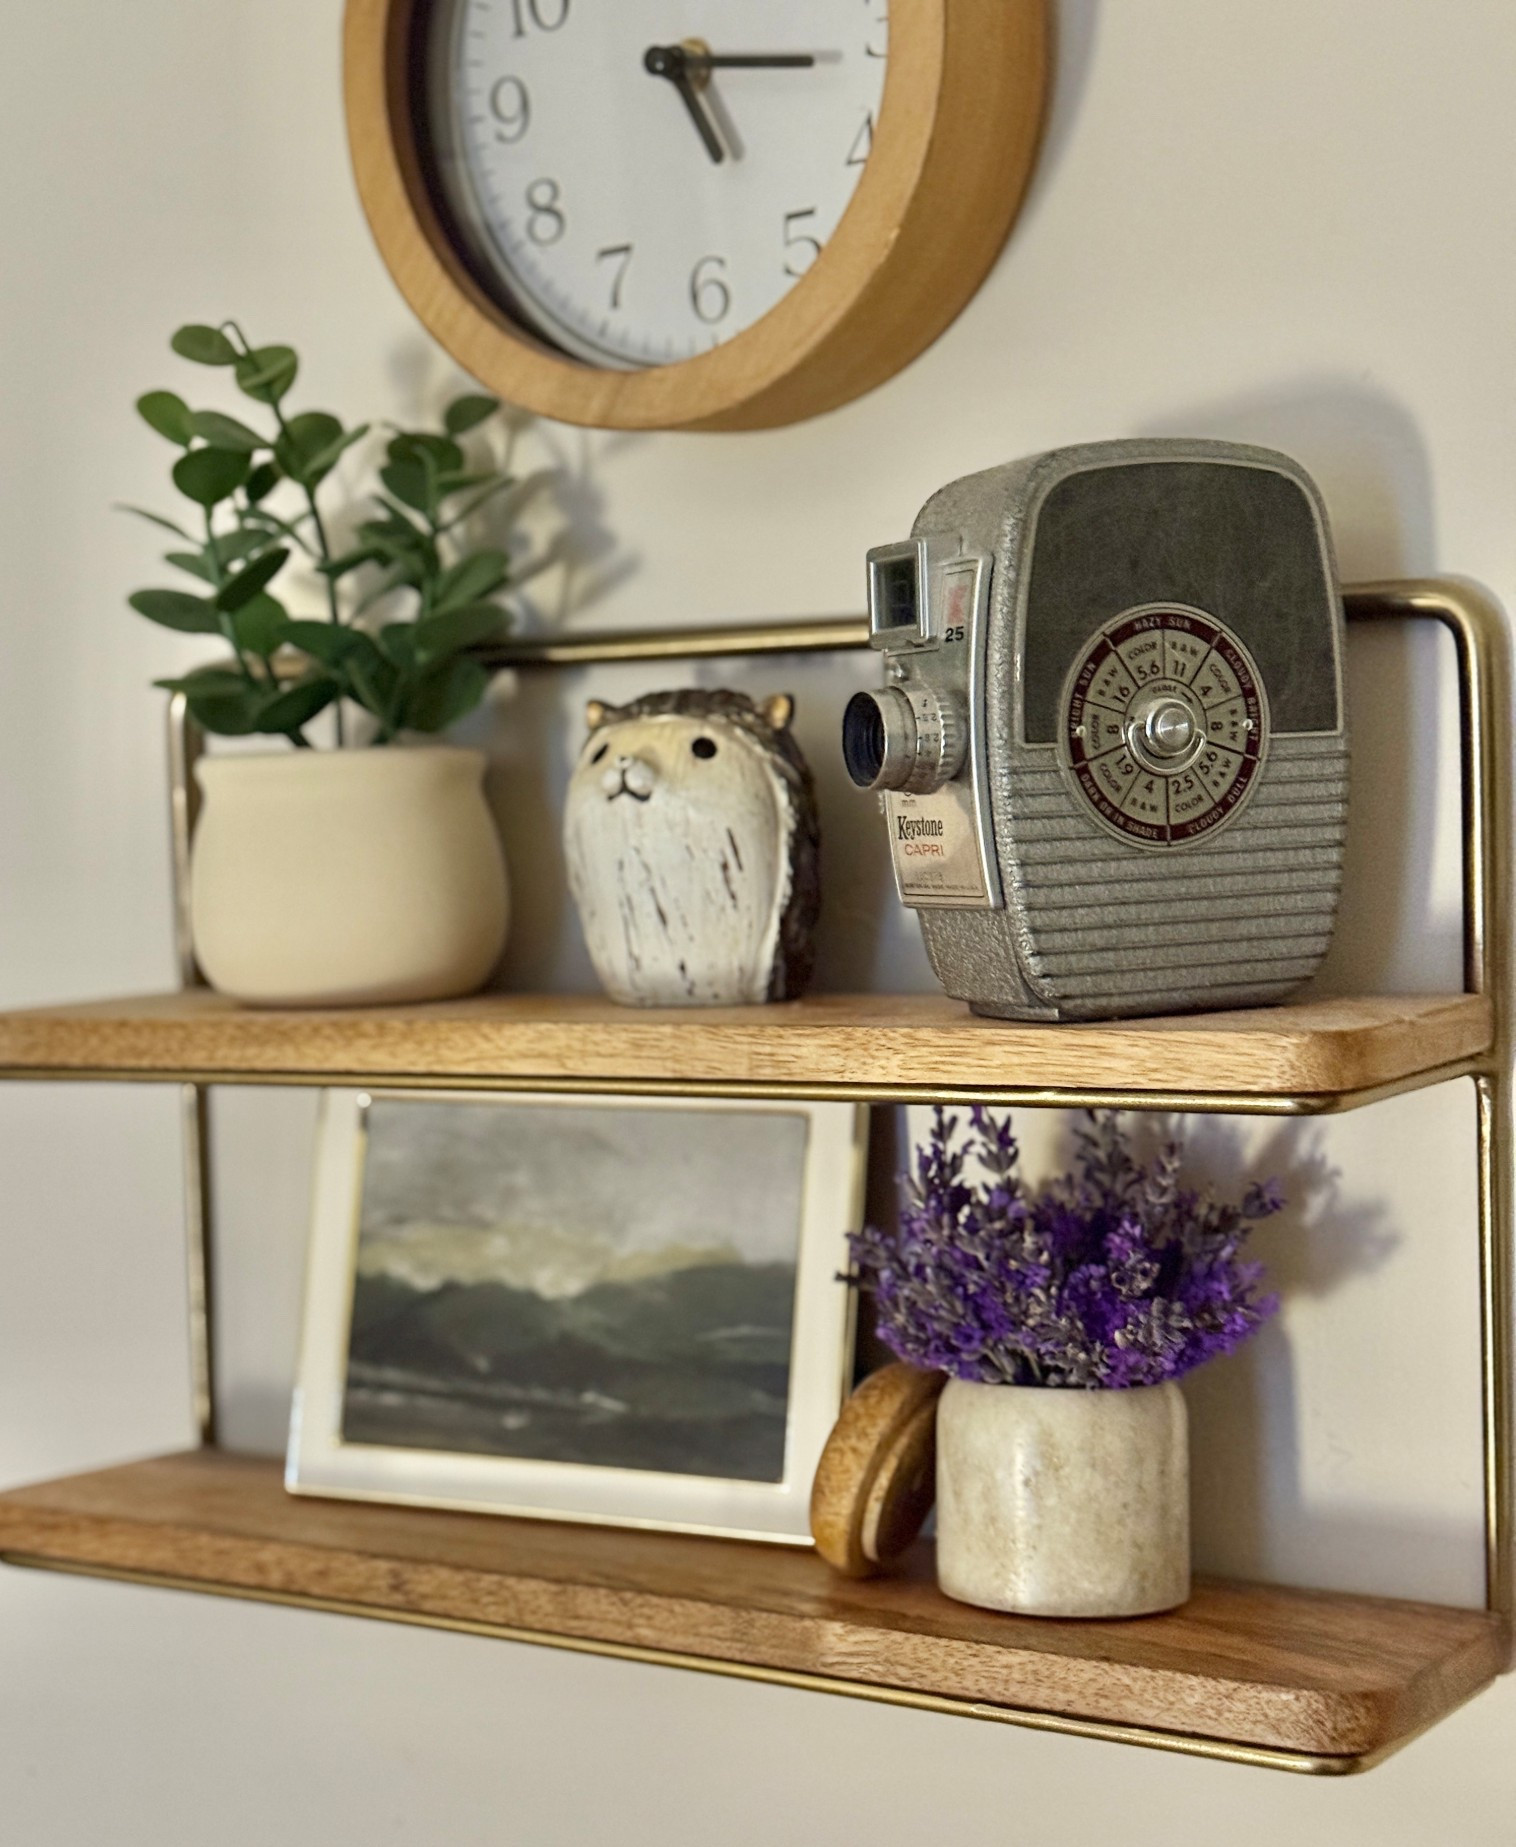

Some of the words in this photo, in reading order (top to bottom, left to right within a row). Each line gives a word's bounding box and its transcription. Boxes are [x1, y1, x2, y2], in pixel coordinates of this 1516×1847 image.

[510, 0, 571, 39] 10
[488, 74, 531, 145] 9
[525, 177, 566, 247] 8
[783, 207, 822, 277] 5
[595, 243, 633, 310] 7
[688, 254, 731, 325] 6
[944, 626, 964, 642] 25
[1134, 616, 1160, 631] HAZY
[1169, 616, 1191, 630] SUN
[1128, 641, 1157, 660] COLOR
[1079, 661, 1097, 686] SUN
[1173, 660, 1186, 677] 11
[1209, 663, 1232, 694] COLOR
[1224, 648, 1252, 689] CLOUDY
[1112, 686, 1130, 704] 16
[1200, 685, 1213, 697] 4
[1091, 714, 1101, 750] COLOR
[1107, 724, 1120, 735] 8
[1210, 721, 1223, 731] 8
[1199, 751, 1218, 775] 5.6
[1100, 763, 1122, 793] COLOR
[1143, 780, 1154, 794] 4
[1171, 775, 1194, 795] 2.5
[1175, 794, 1204, 813] COLOR
[1188, 806, 1224, 834] CLOUDY
[1226, 776, 1248, 804] DULL
[897, 815, 943, 840] Keystone
[1125, 820, 1158, 839] SHADE
[904, 843, 944, 856] CAPRI
